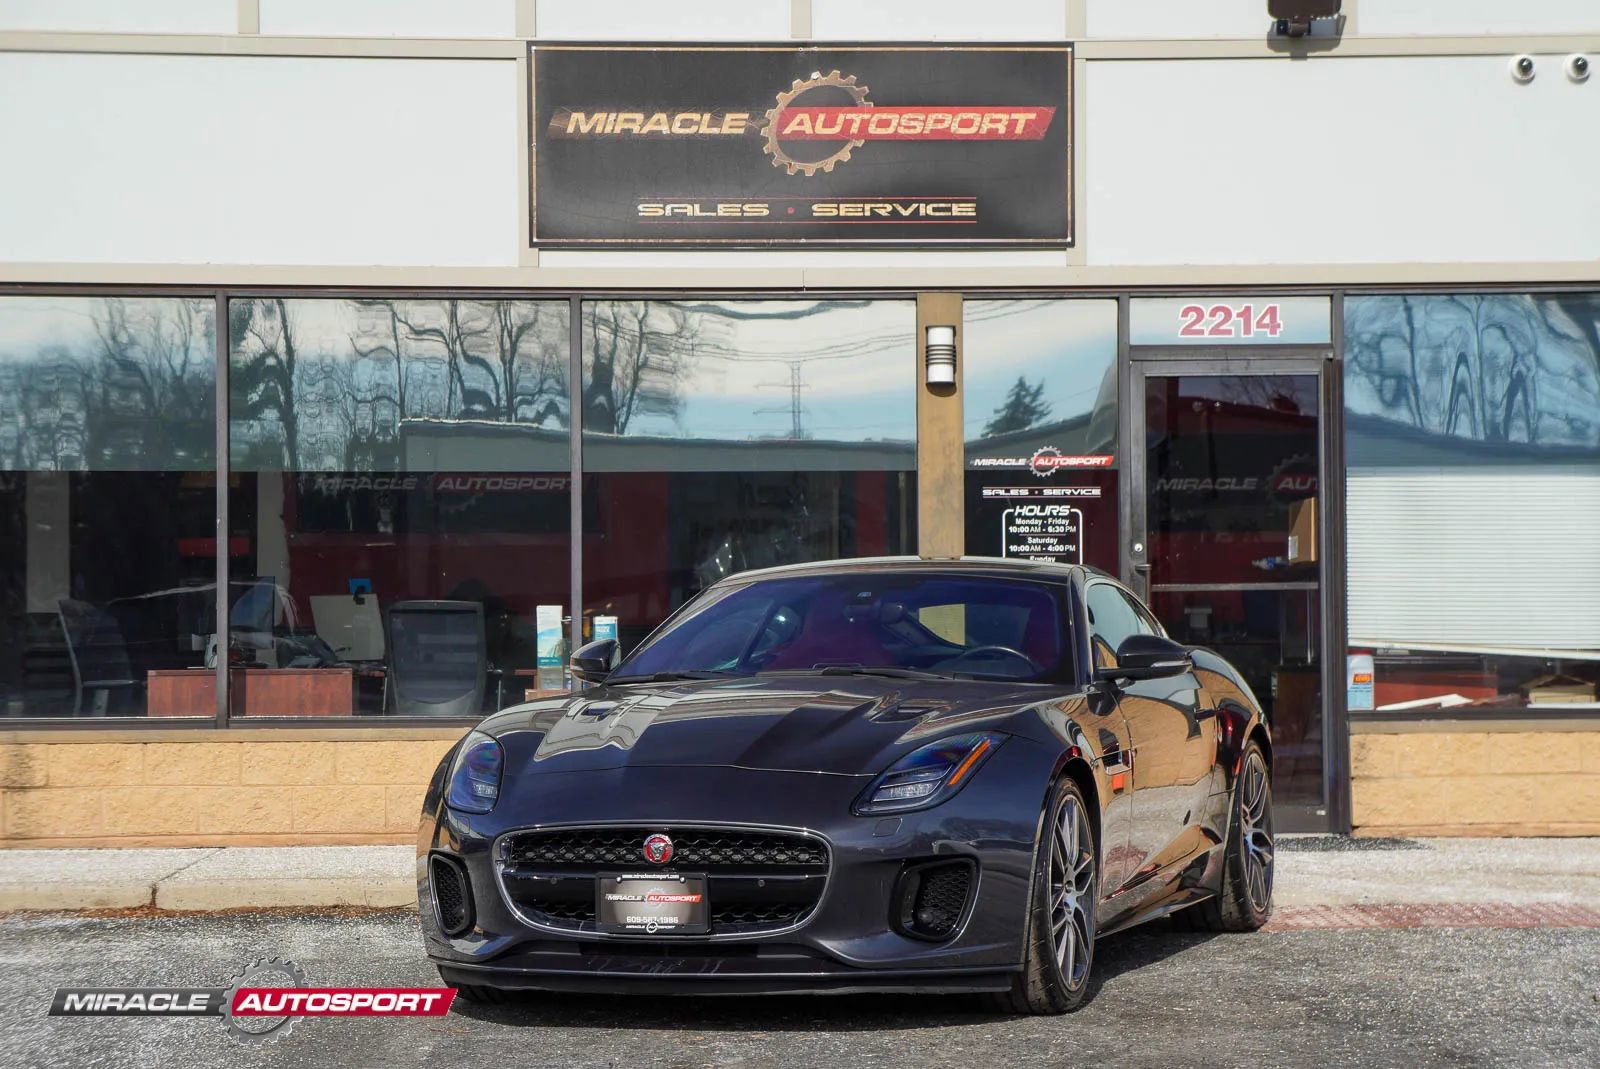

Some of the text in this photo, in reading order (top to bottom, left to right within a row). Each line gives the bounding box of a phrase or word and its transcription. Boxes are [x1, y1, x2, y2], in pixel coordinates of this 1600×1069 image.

[566, 112, 1039, 136] MIRACLE AUTOSPORT
[637, 203, 977, 217] SALES SERVICE
[1179, 304, 1283, 337] 2214
[974, 457, 1109, 466] MIRACLE AUTOSPORT
[314, 478, 418, 490] MIRACLE
[1155, 477, 1258, 490] MIRACLE
[1014, 505, 1070, 516] HOURS
[1015, 518, 1043, 526] Monday
[1048, 518, 1070, 526] Friday
[1027, 537, 1058, 545] Saturday
